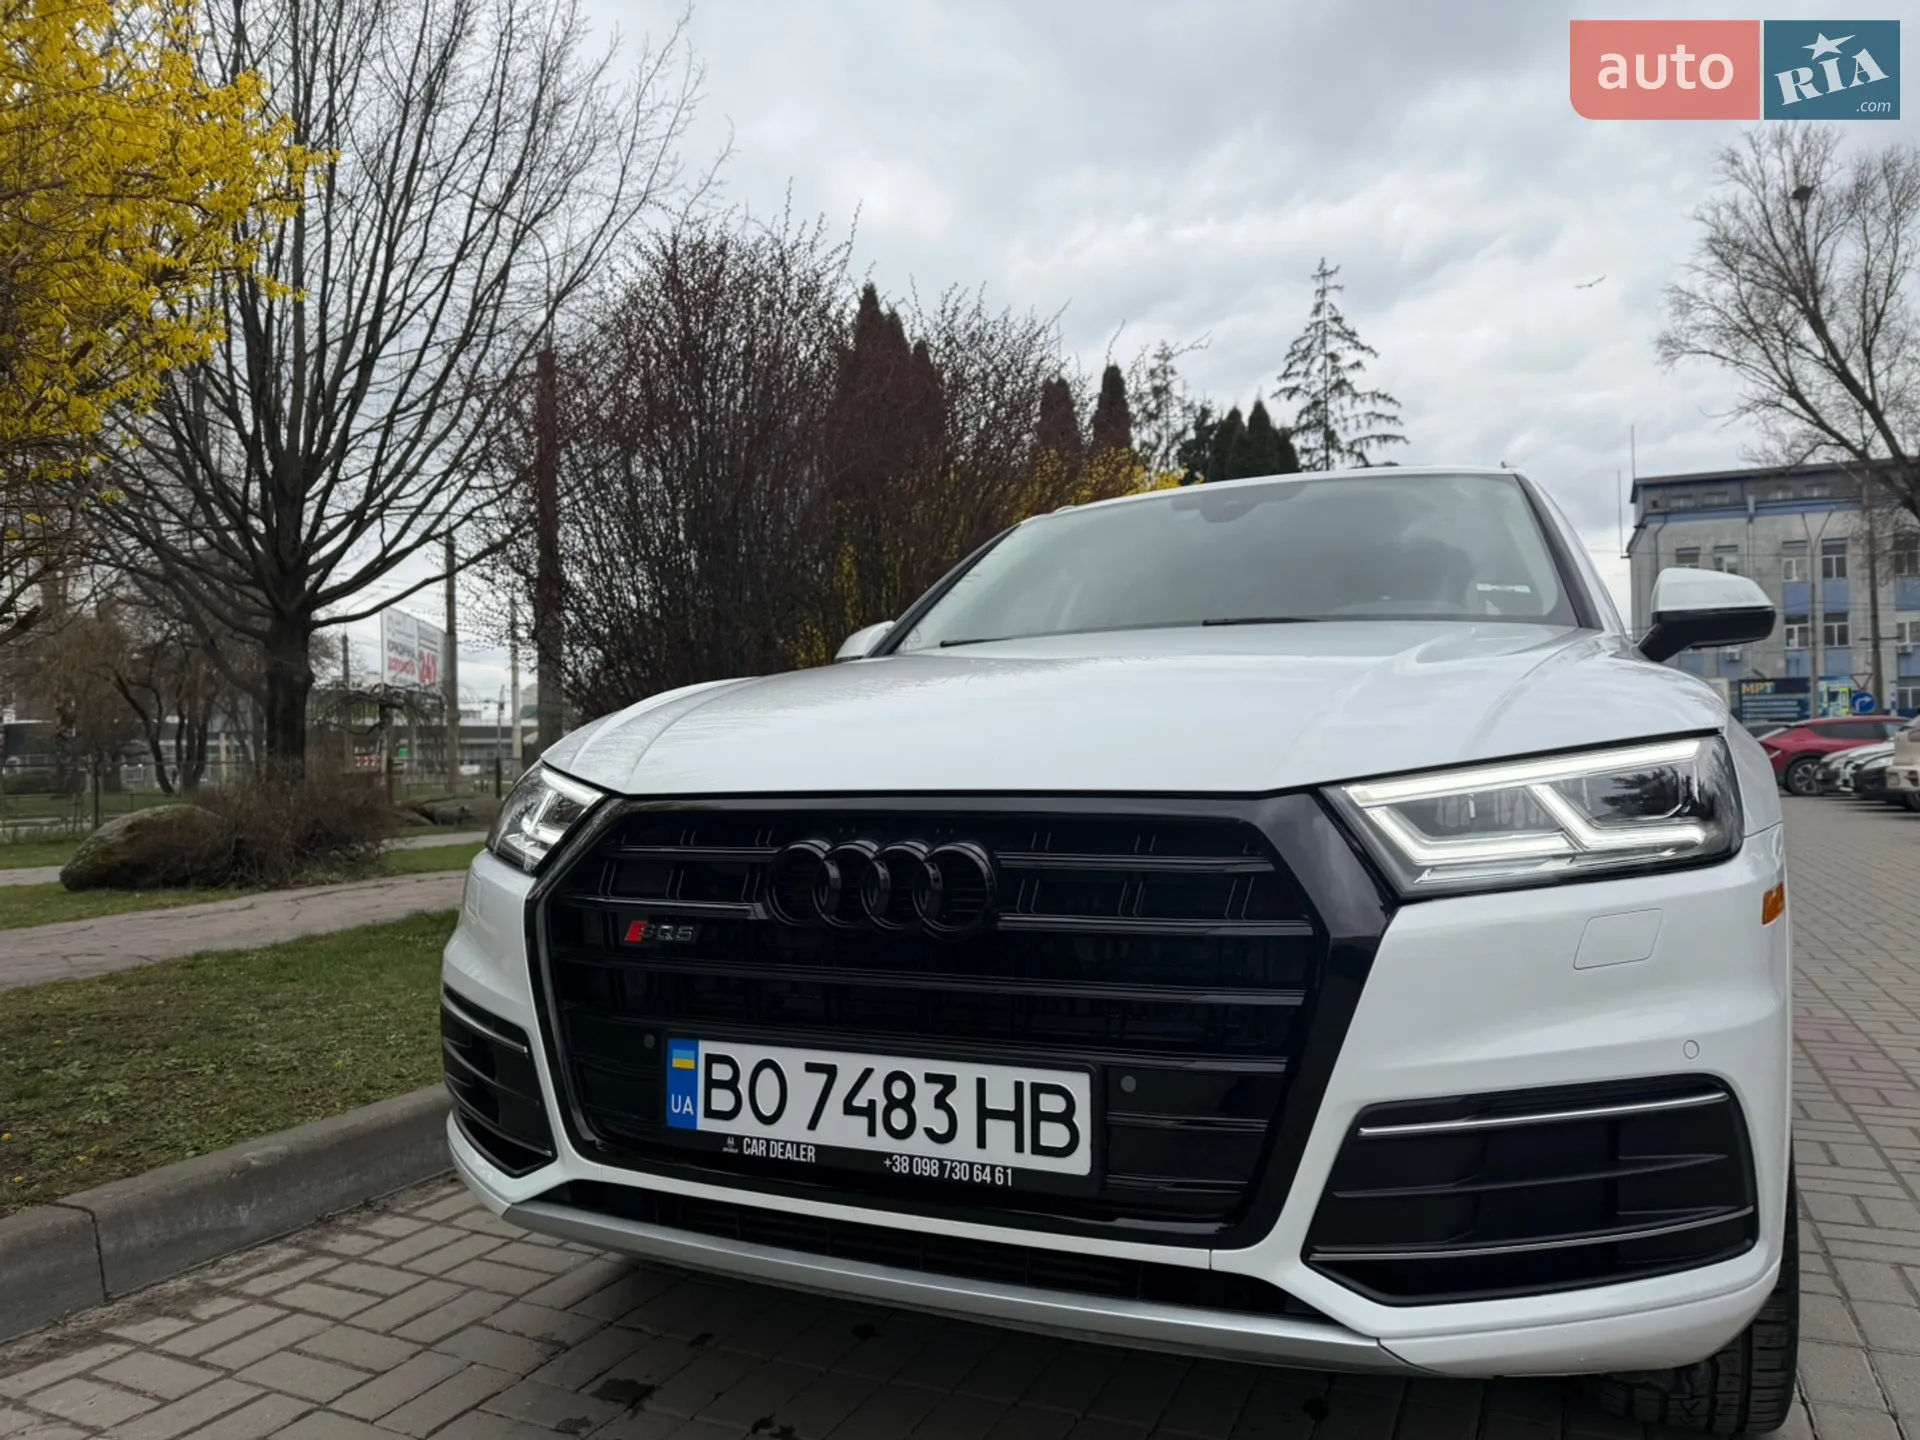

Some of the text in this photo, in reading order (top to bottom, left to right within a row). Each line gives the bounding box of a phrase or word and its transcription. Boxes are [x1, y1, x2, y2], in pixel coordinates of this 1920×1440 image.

[670, 1093, 694, 1116] UA
[703, 1052, 1081, 1159] BO 7483 HB
[743, 1137, 767, 1157] CAR
[769, 1141, 816, 1163] DEALER
[883, 1154, 1013, 1187] +38 098 730 64 61
